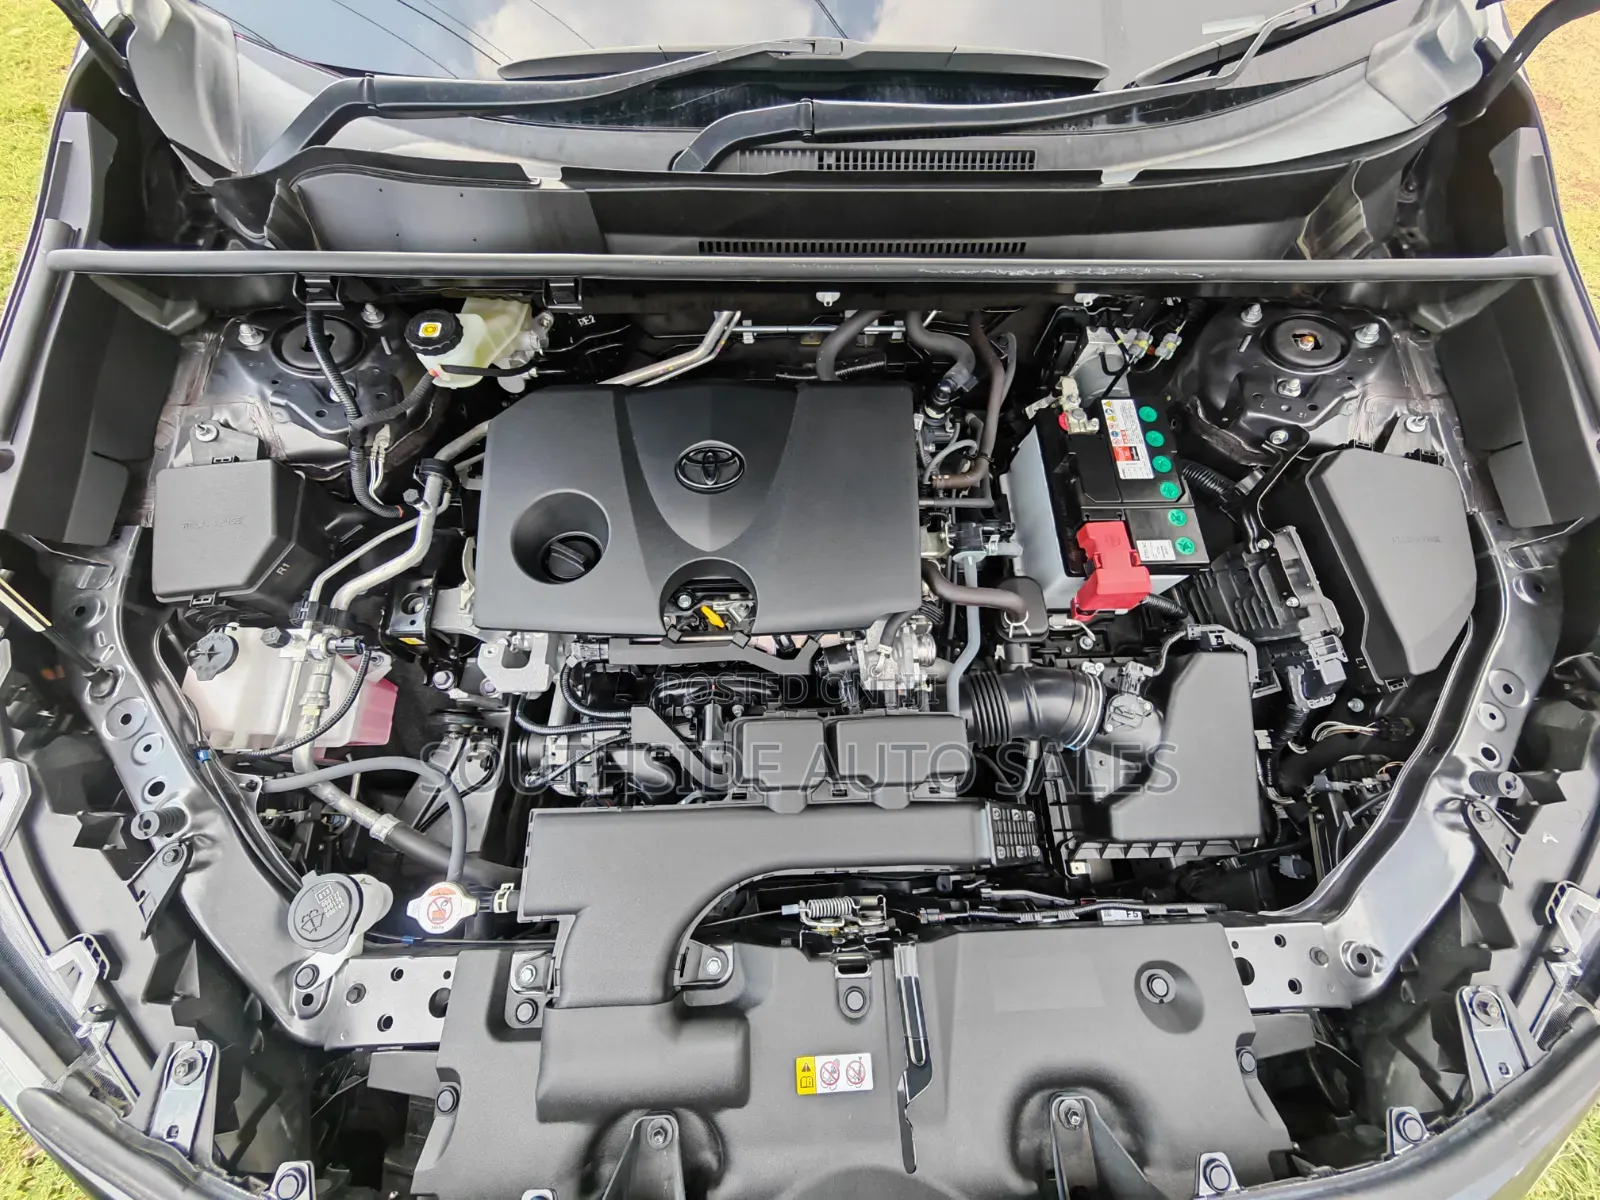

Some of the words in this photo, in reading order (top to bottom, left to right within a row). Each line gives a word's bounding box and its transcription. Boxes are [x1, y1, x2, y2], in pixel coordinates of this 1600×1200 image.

[275, 562, 290, 575] R1
[199, 634, 229, 645] COOLANT
[1126, 910, 1139, 918] F5
